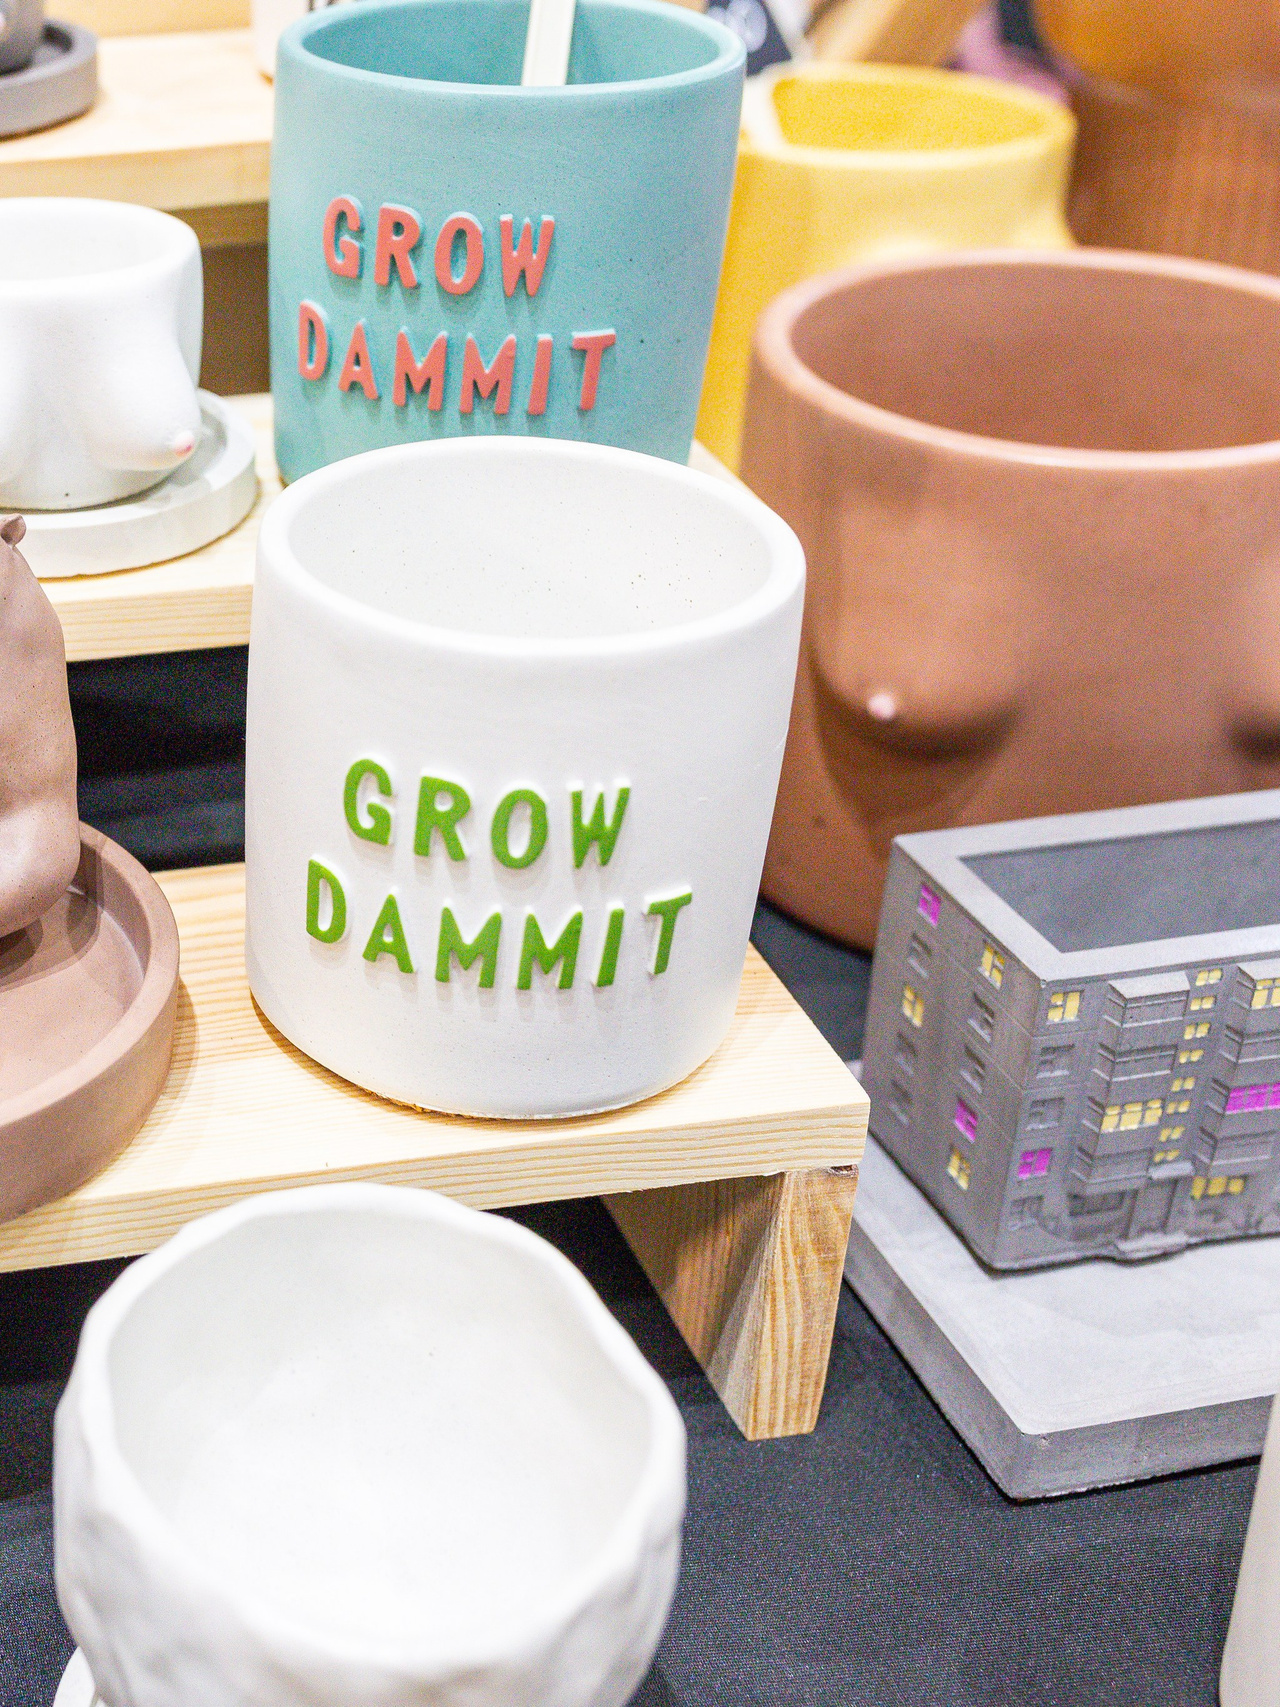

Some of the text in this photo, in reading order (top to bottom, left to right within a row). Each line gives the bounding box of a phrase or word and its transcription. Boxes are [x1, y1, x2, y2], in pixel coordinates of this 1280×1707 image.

[322, 196, 556, 298] GROW
[298, 302, 617, 416] DAMMIT
[343, 758, 632, 870] GROW
[306, 858, 694, 991] DAMMIT
